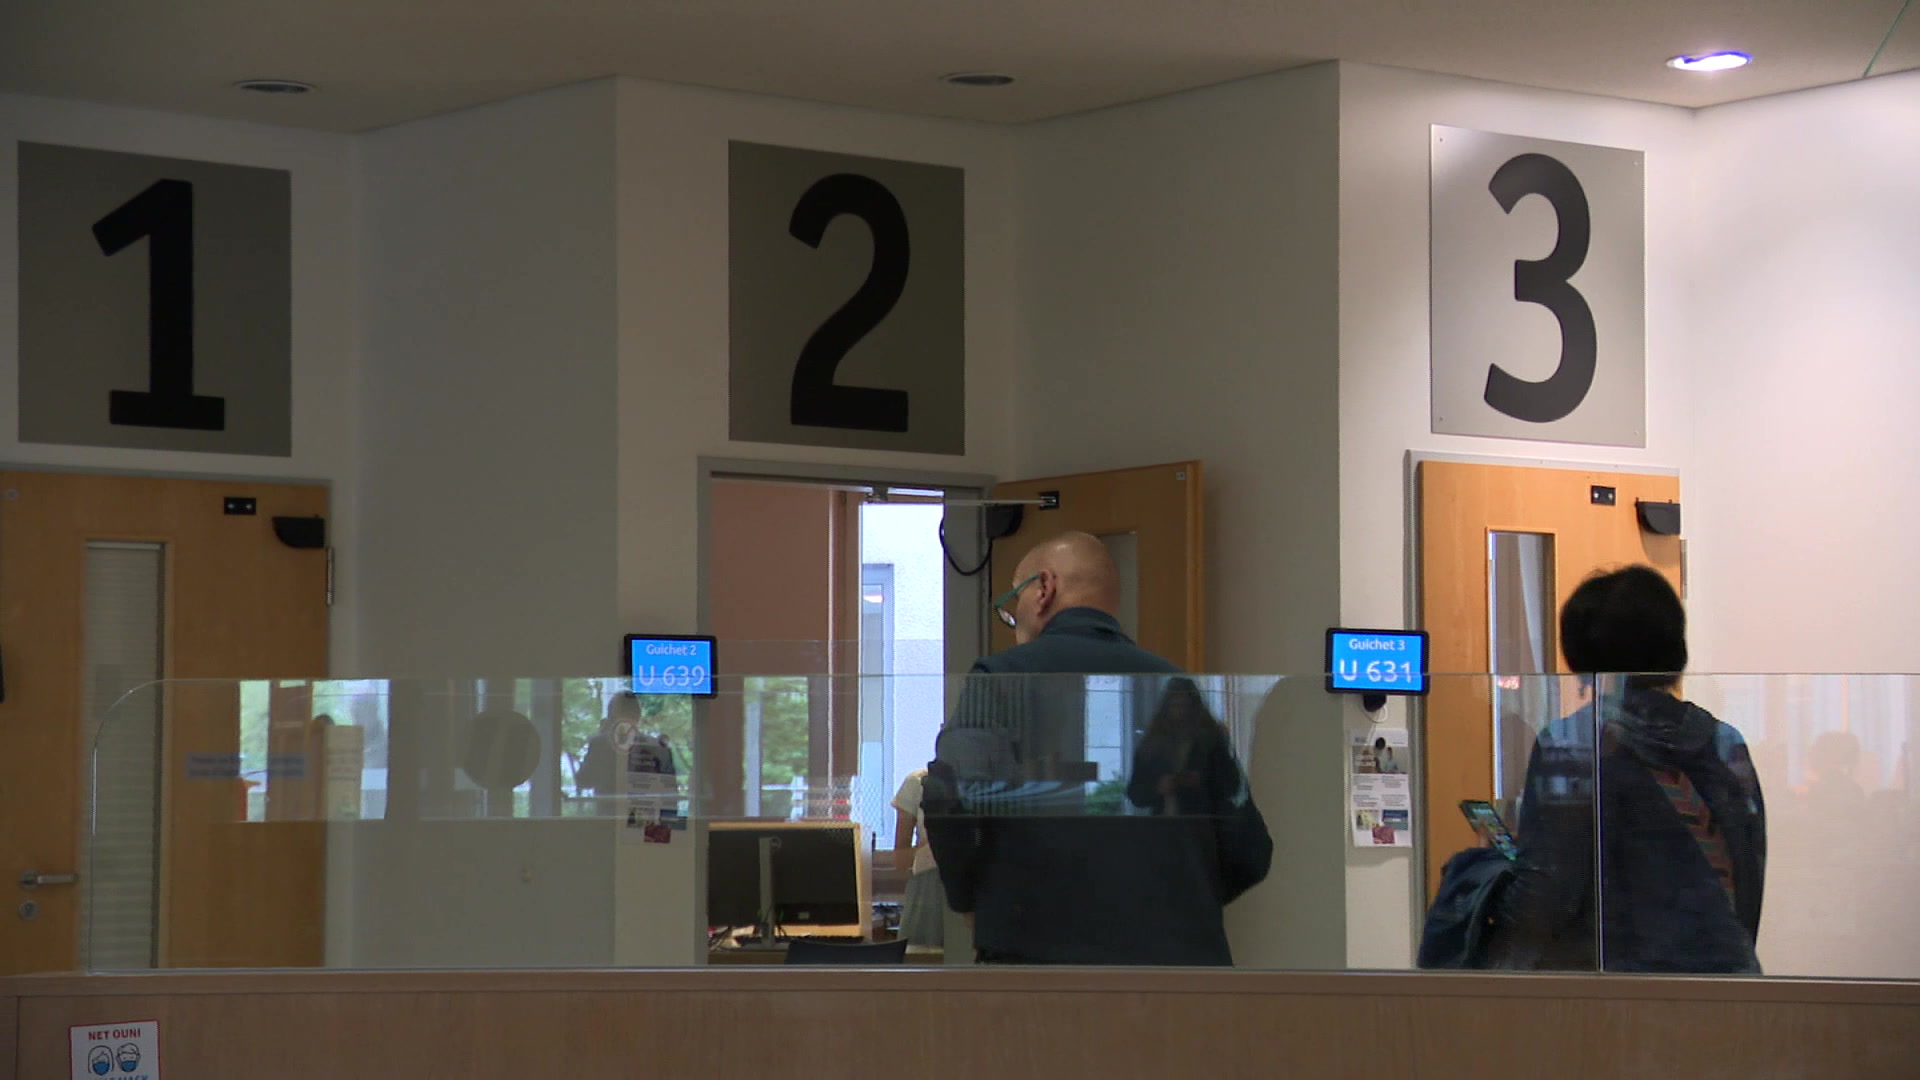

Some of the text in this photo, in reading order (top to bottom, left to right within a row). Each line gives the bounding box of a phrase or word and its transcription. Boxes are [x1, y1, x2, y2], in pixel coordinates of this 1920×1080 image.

[1484, 152, 1597, 423] 3
[92, 179, 225, 432] 1
[788, 173, 911, 433] 2
[646, 643, 697, 656] Guichet 2
[1349, 638, 1406, 651] Guichet 3
[639, 665, 705, 686] U 639
[1339, 659, 1412, 683] U 631
[88, 1028, 141, 1041] NET OUNI
